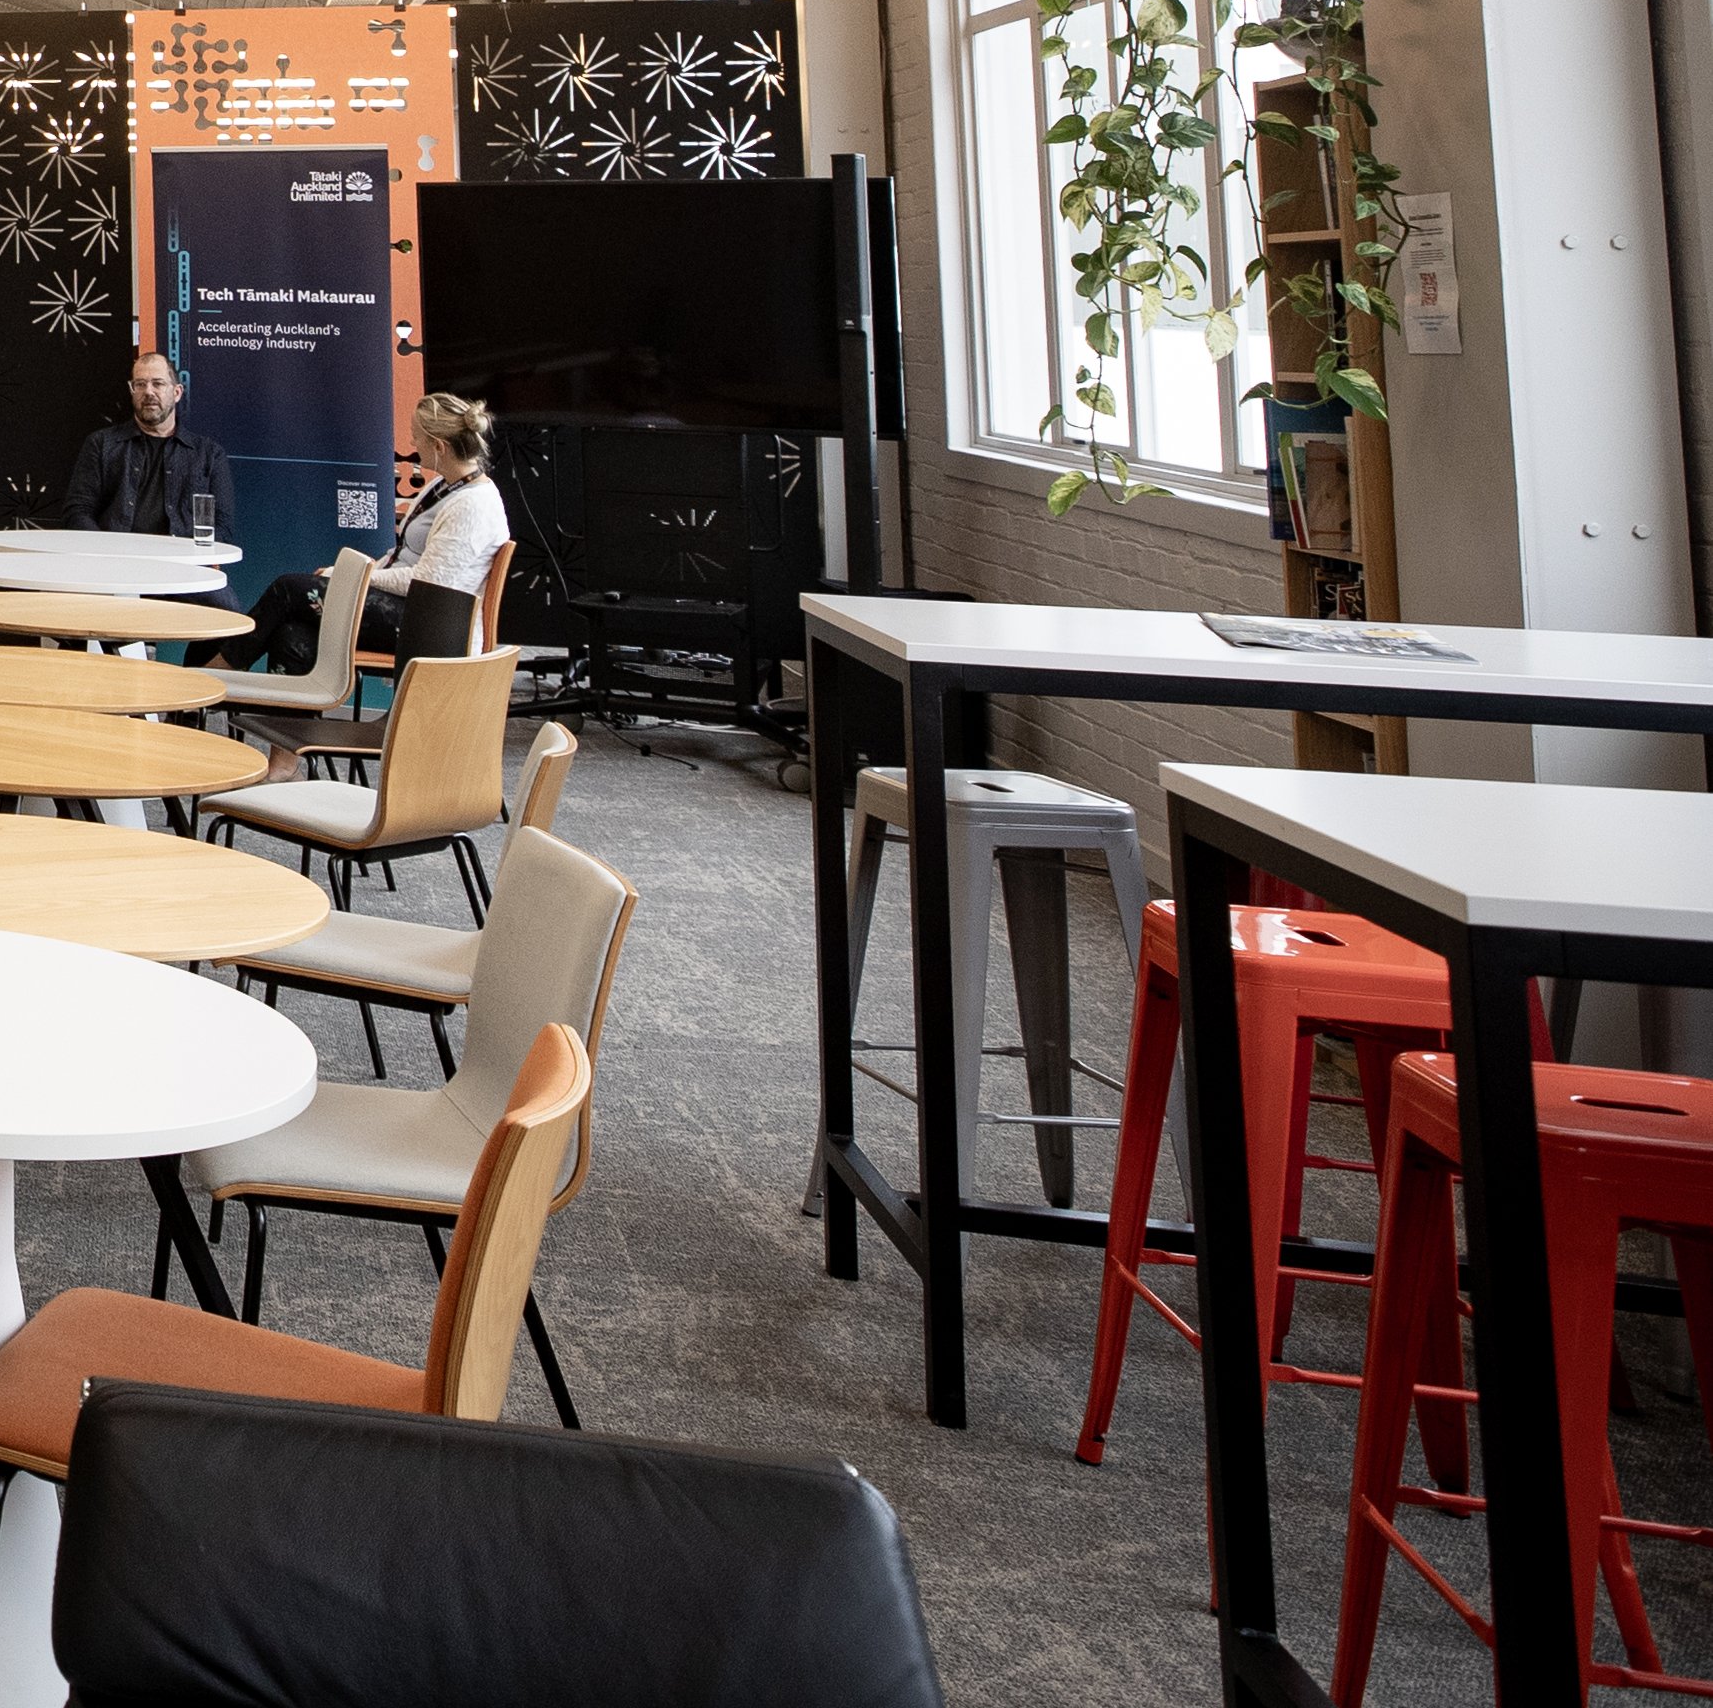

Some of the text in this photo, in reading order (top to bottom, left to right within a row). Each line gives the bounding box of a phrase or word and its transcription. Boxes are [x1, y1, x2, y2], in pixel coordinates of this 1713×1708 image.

[291, 181, 342, 191] Auckland
[291, 191, 342, 201] Unlimited
[197, 288, 376, 305] Tech Tāmaki Makaurau
[197, 321, 341, 336] Accelerating Auckland’s
[197, 335, 316, 352] technology industry
